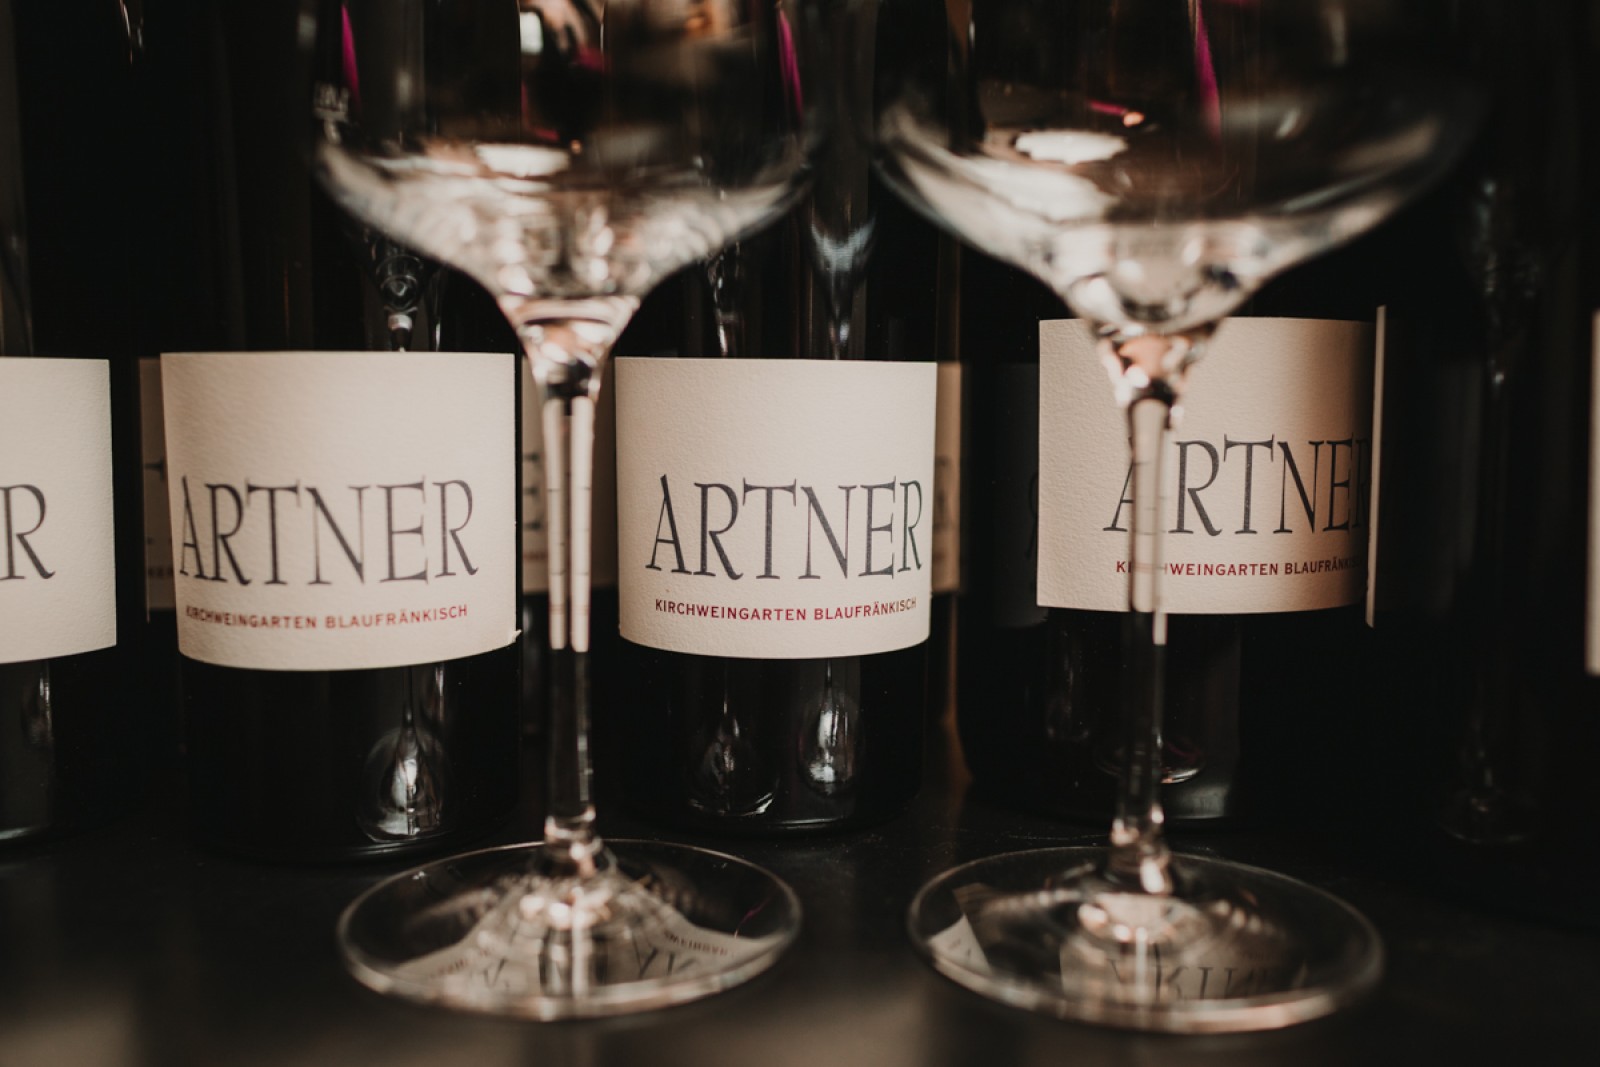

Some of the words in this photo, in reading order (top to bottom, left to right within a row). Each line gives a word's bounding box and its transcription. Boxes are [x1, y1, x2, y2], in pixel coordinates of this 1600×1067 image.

[180, 475, 479, 586] ARTNER
[645, 474, 923, 580] ARTNER
[1116, 560, 1279, 576] KIWEINGARTEN
[185, 605, 317, 629] KIRCHWEINGARTEN
[325, 604, 468, 628] BLAUFRÄNKISCH
[655, 599, 807, 621] KIRCHWEINGARTEN
[814, 596, 917, 621] BLAUFRÄNKISCH
